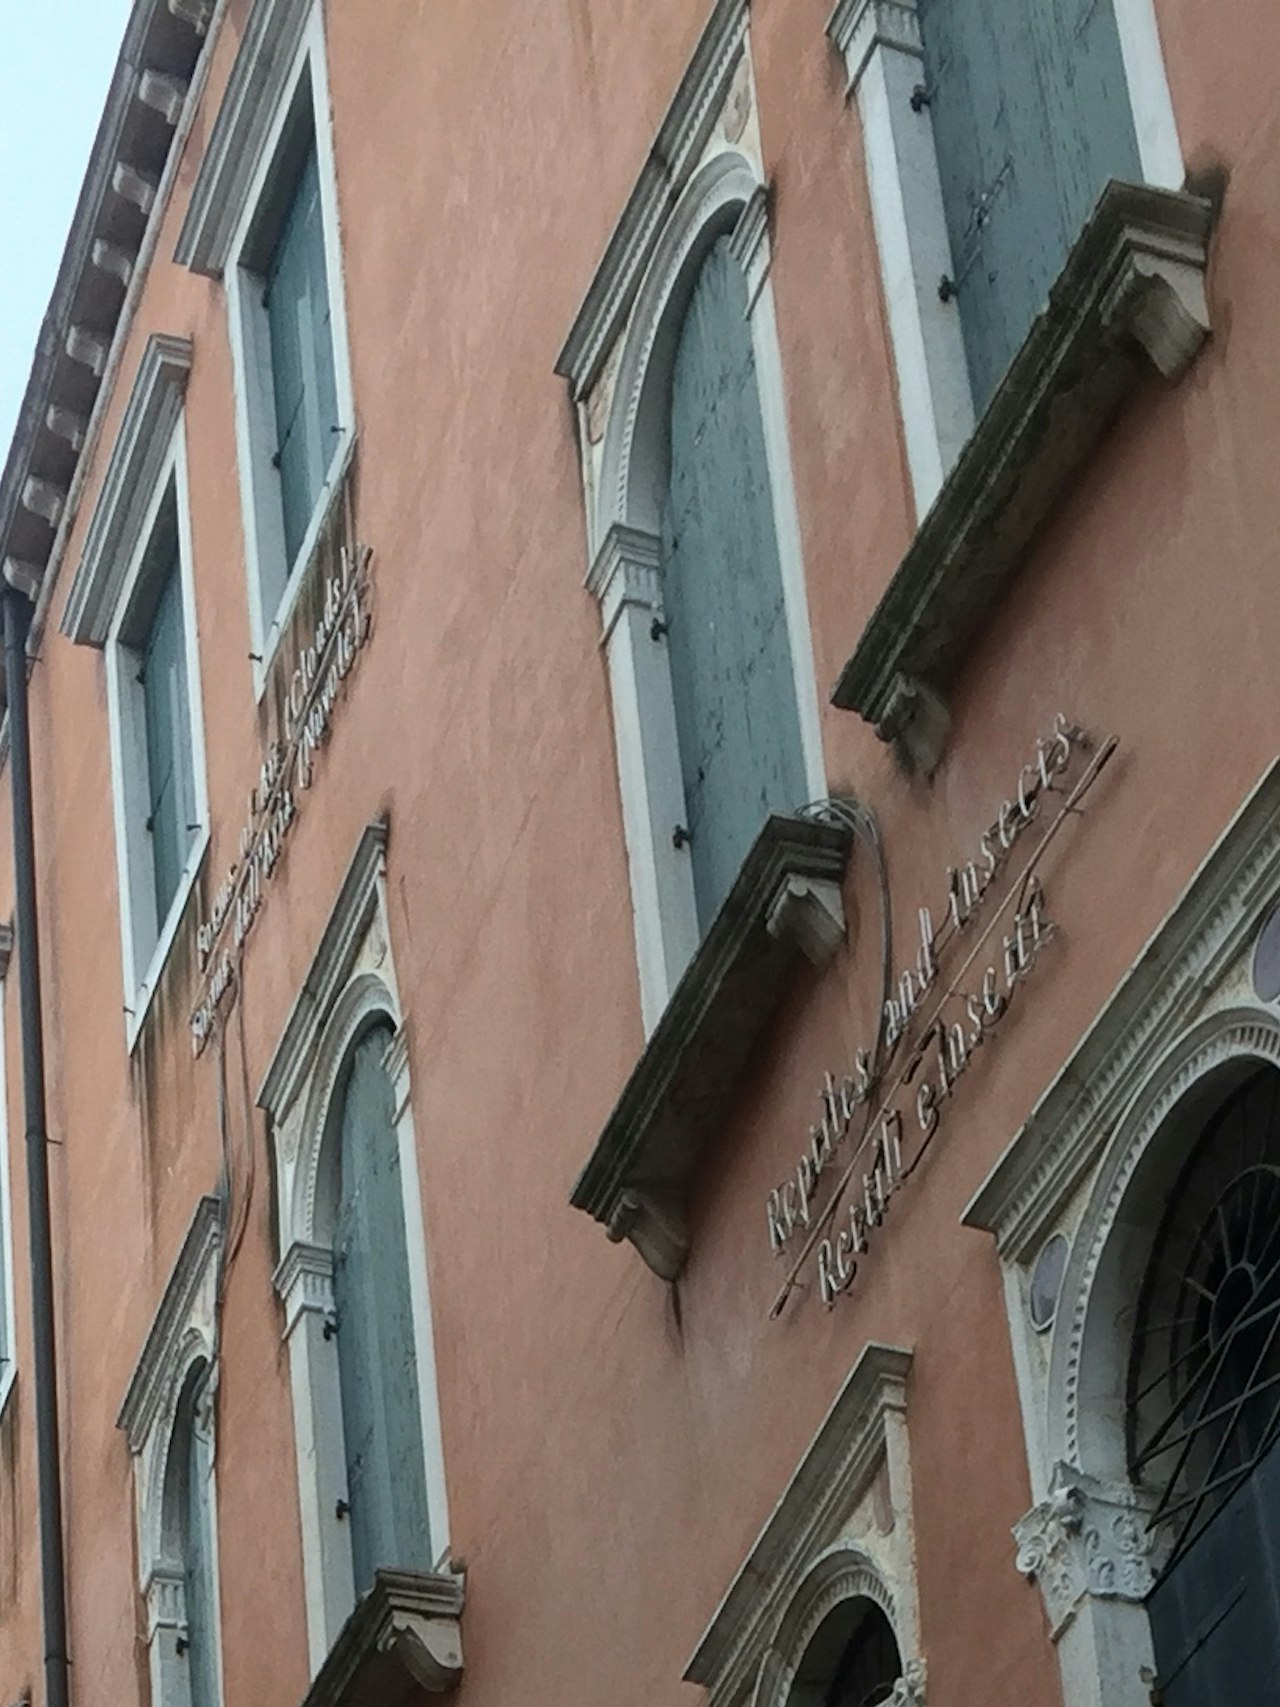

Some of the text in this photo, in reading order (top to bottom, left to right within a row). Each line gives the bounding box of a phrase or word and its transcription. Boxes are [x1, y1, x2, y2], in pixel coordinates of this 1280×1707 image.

[766, 1046, 869, 1252] Reptiles
[884, 907, 935, 1047] and
[817, 1110, 902, 1303] Rettili
[917, 1083, 936, 1132] e
